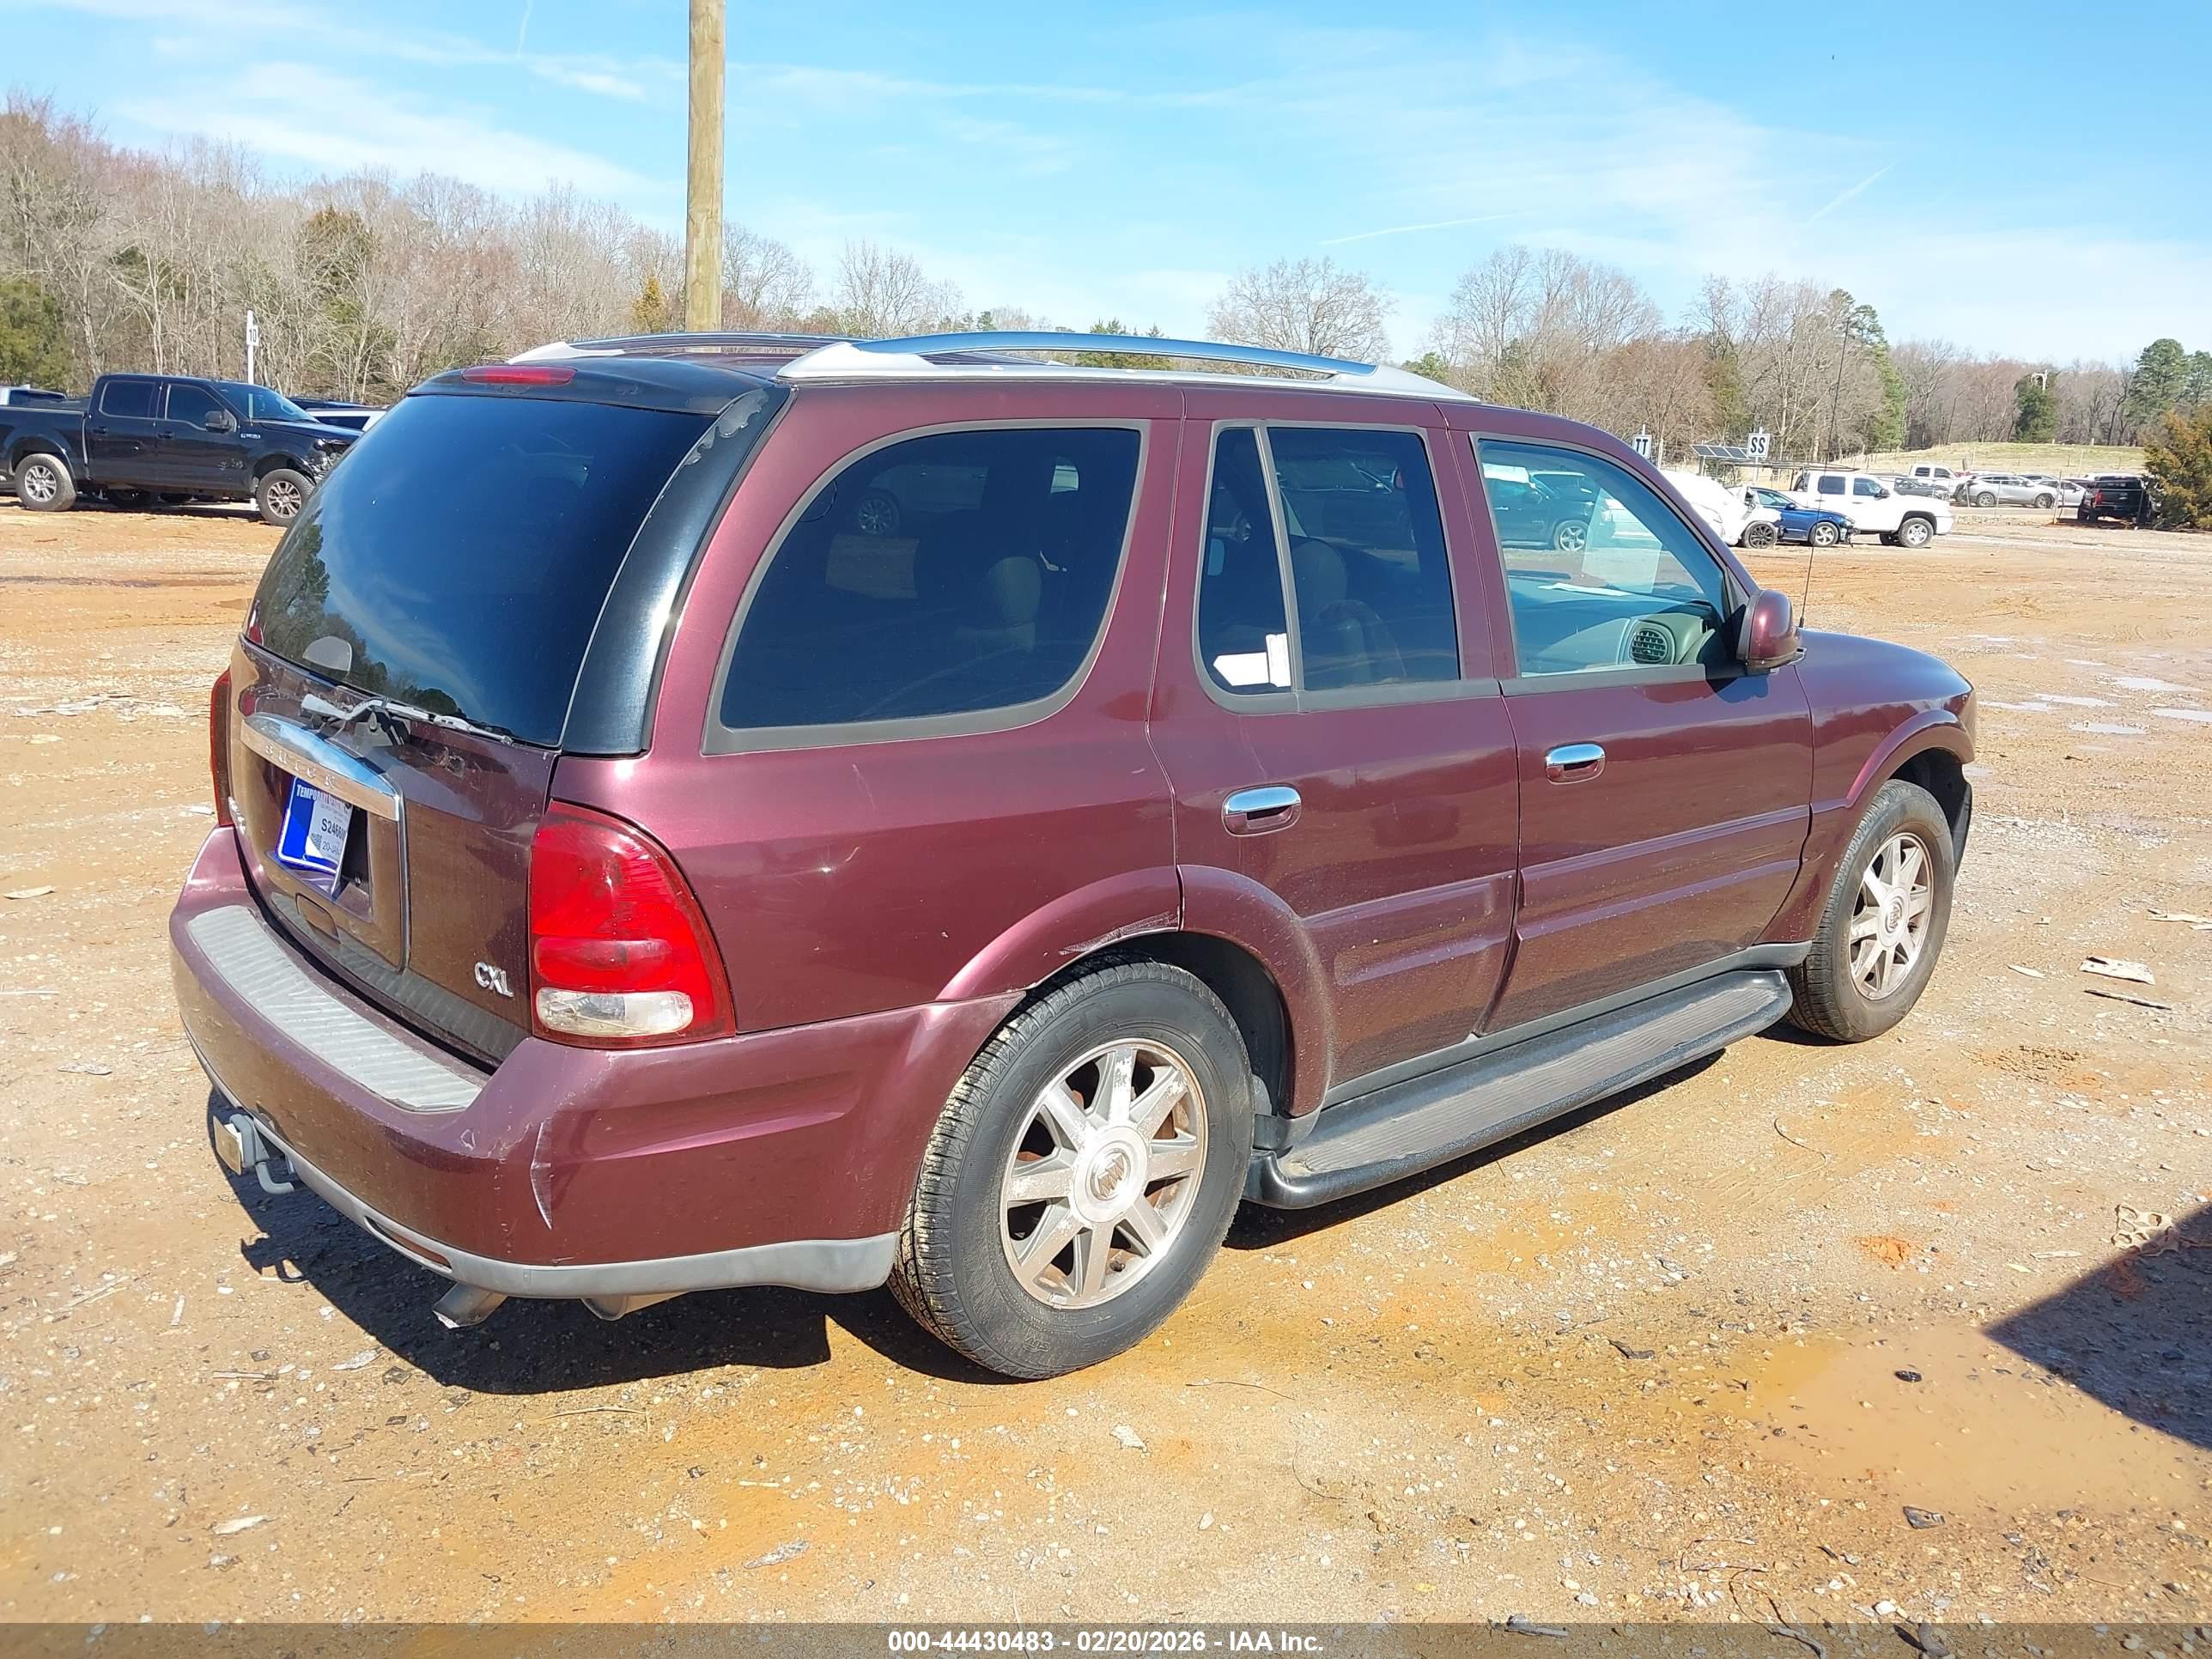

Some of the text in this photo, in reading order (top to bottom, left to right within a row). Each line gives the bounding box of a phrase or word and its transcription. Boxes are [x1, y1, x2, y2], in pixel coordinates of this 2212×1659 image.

[1636, 439, 1649, 455] TT
[1750, 436, 1766, 453] SS
[265, 741, 336, 789] BUICK
[474, 962, 514, 998] CXL
